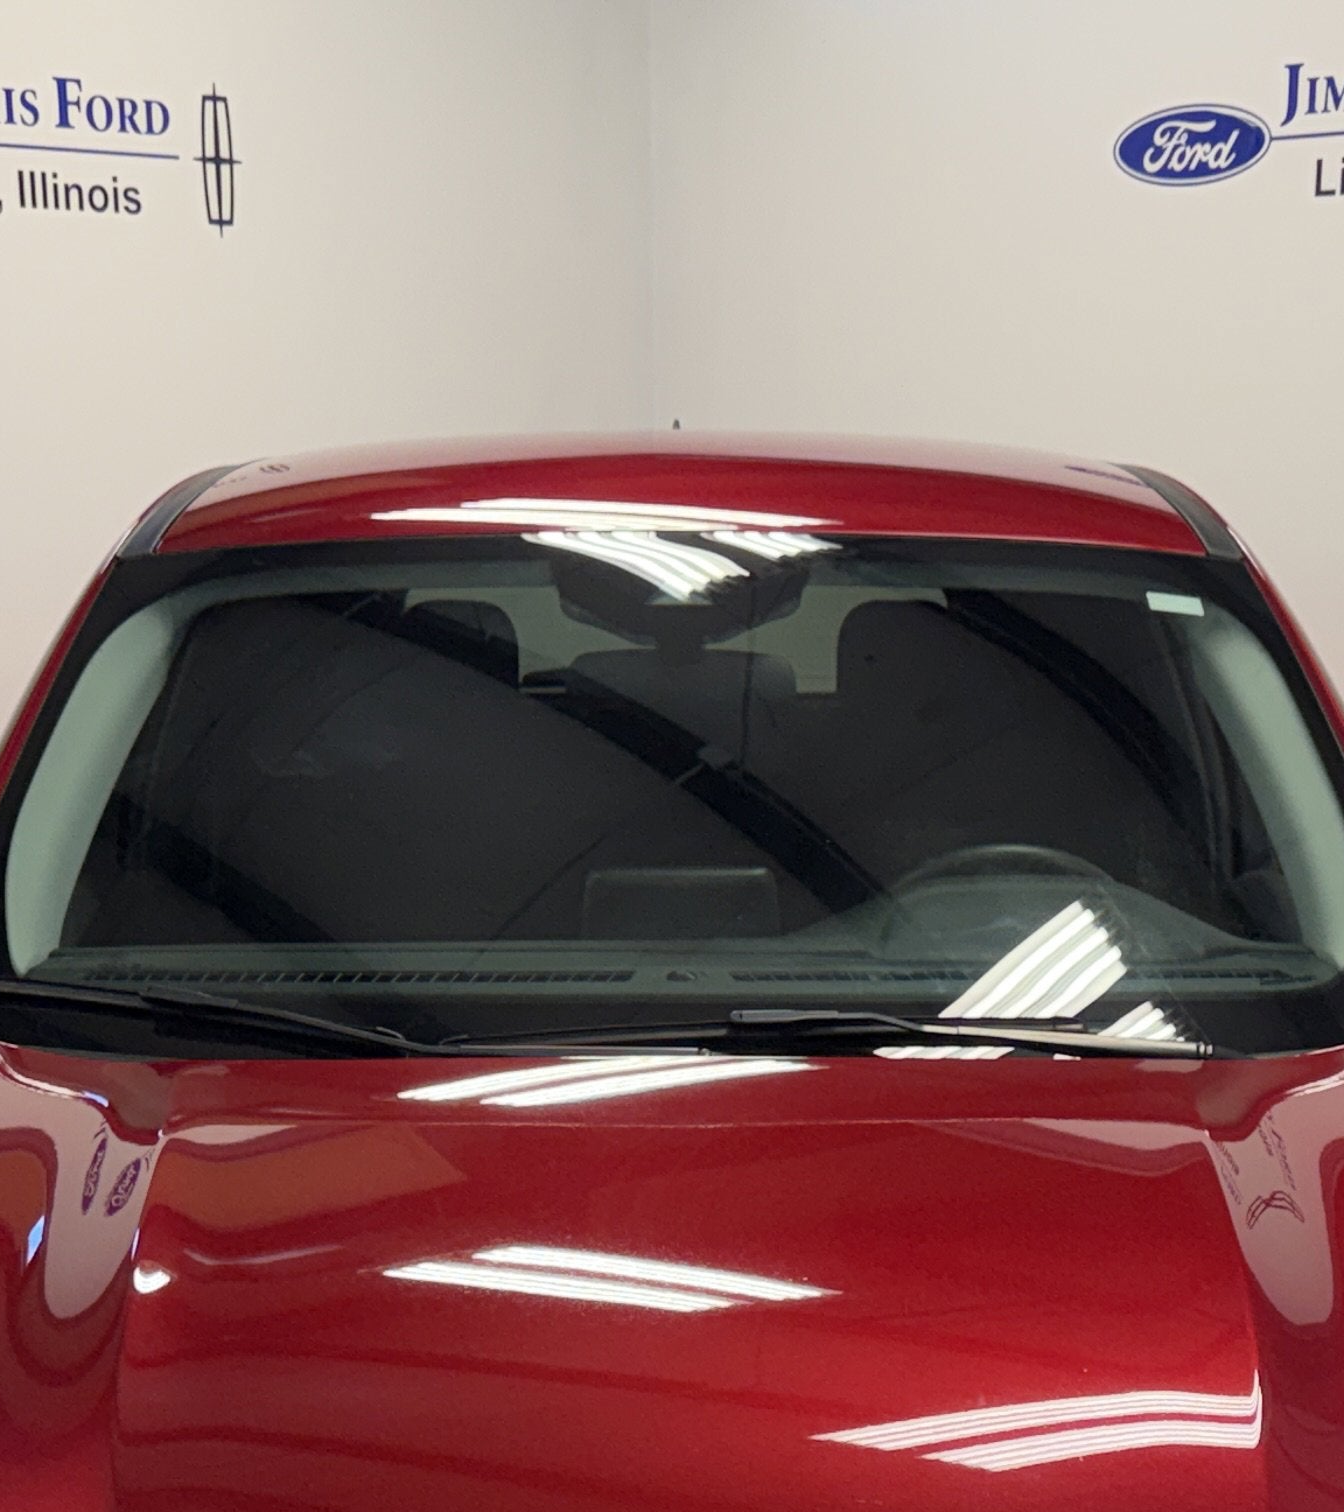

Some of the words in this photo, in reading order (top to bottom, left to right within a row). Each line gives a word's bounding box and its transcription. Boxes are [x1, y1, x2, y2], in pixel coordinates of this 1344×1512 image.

[52, 76, 170, 136] FORD
[1142, 119, 1240, 174] Ford
[17, 169, 142, 215] Illinois
